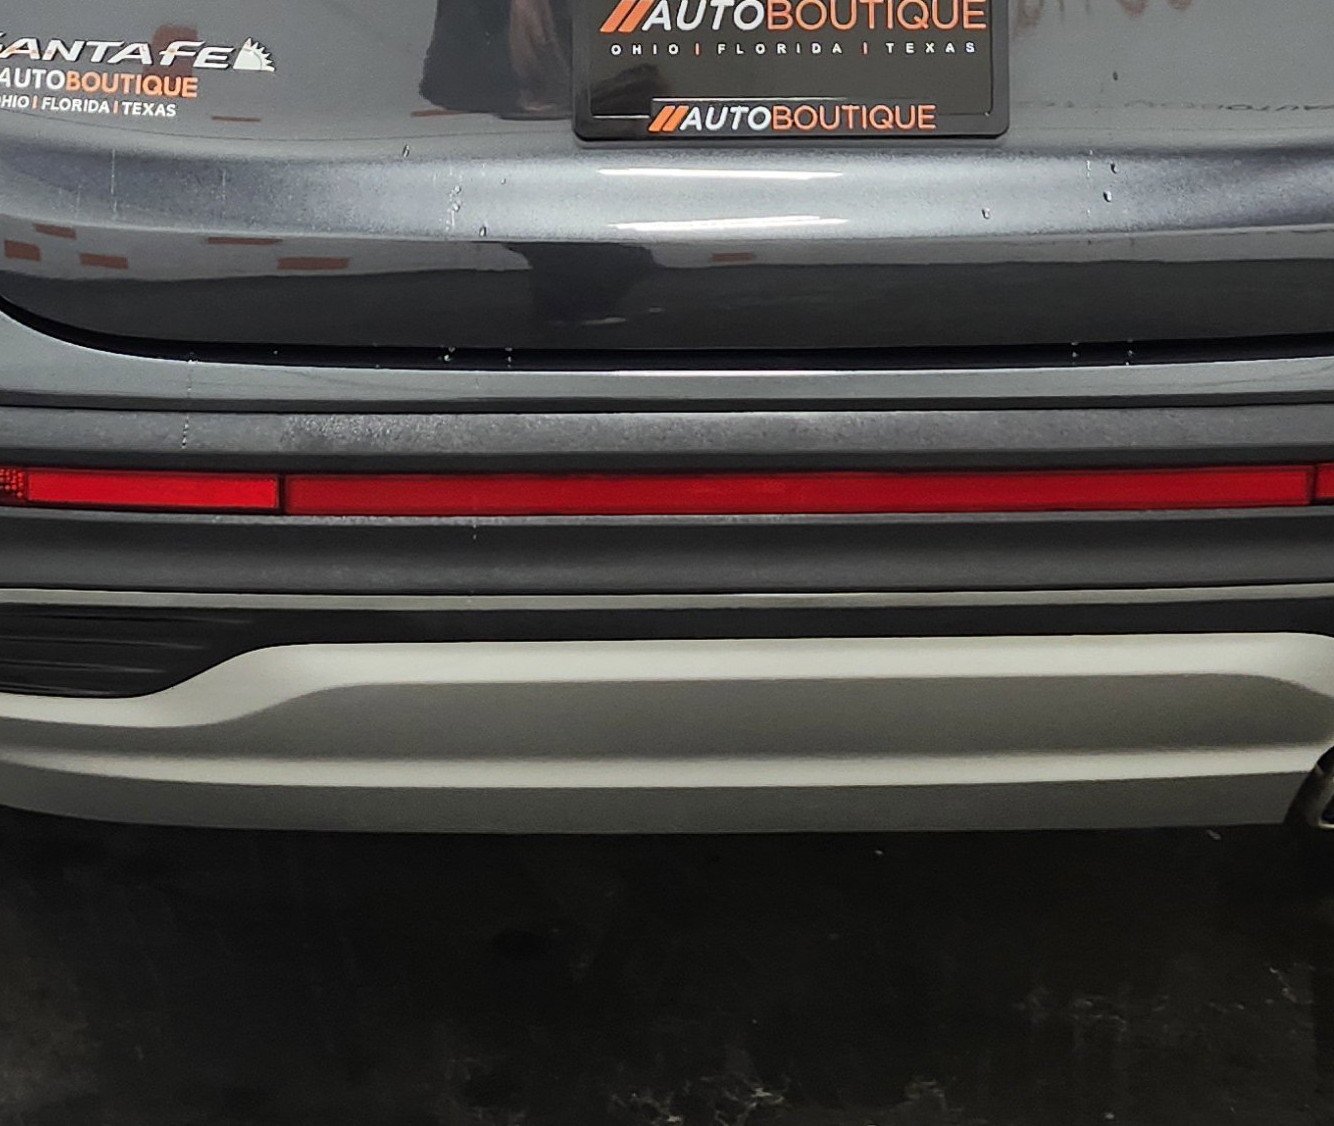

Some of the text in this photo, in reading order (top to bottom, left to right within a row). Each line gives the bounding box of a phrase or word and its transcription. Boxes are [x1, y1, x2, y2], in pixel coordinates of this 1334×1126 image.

[611, 42, 976, 56] OHIO FLORIDA TEXAS
[41, 95, 111, 114] FLORIDA
[121, 100, 178, 118] TEXAS
